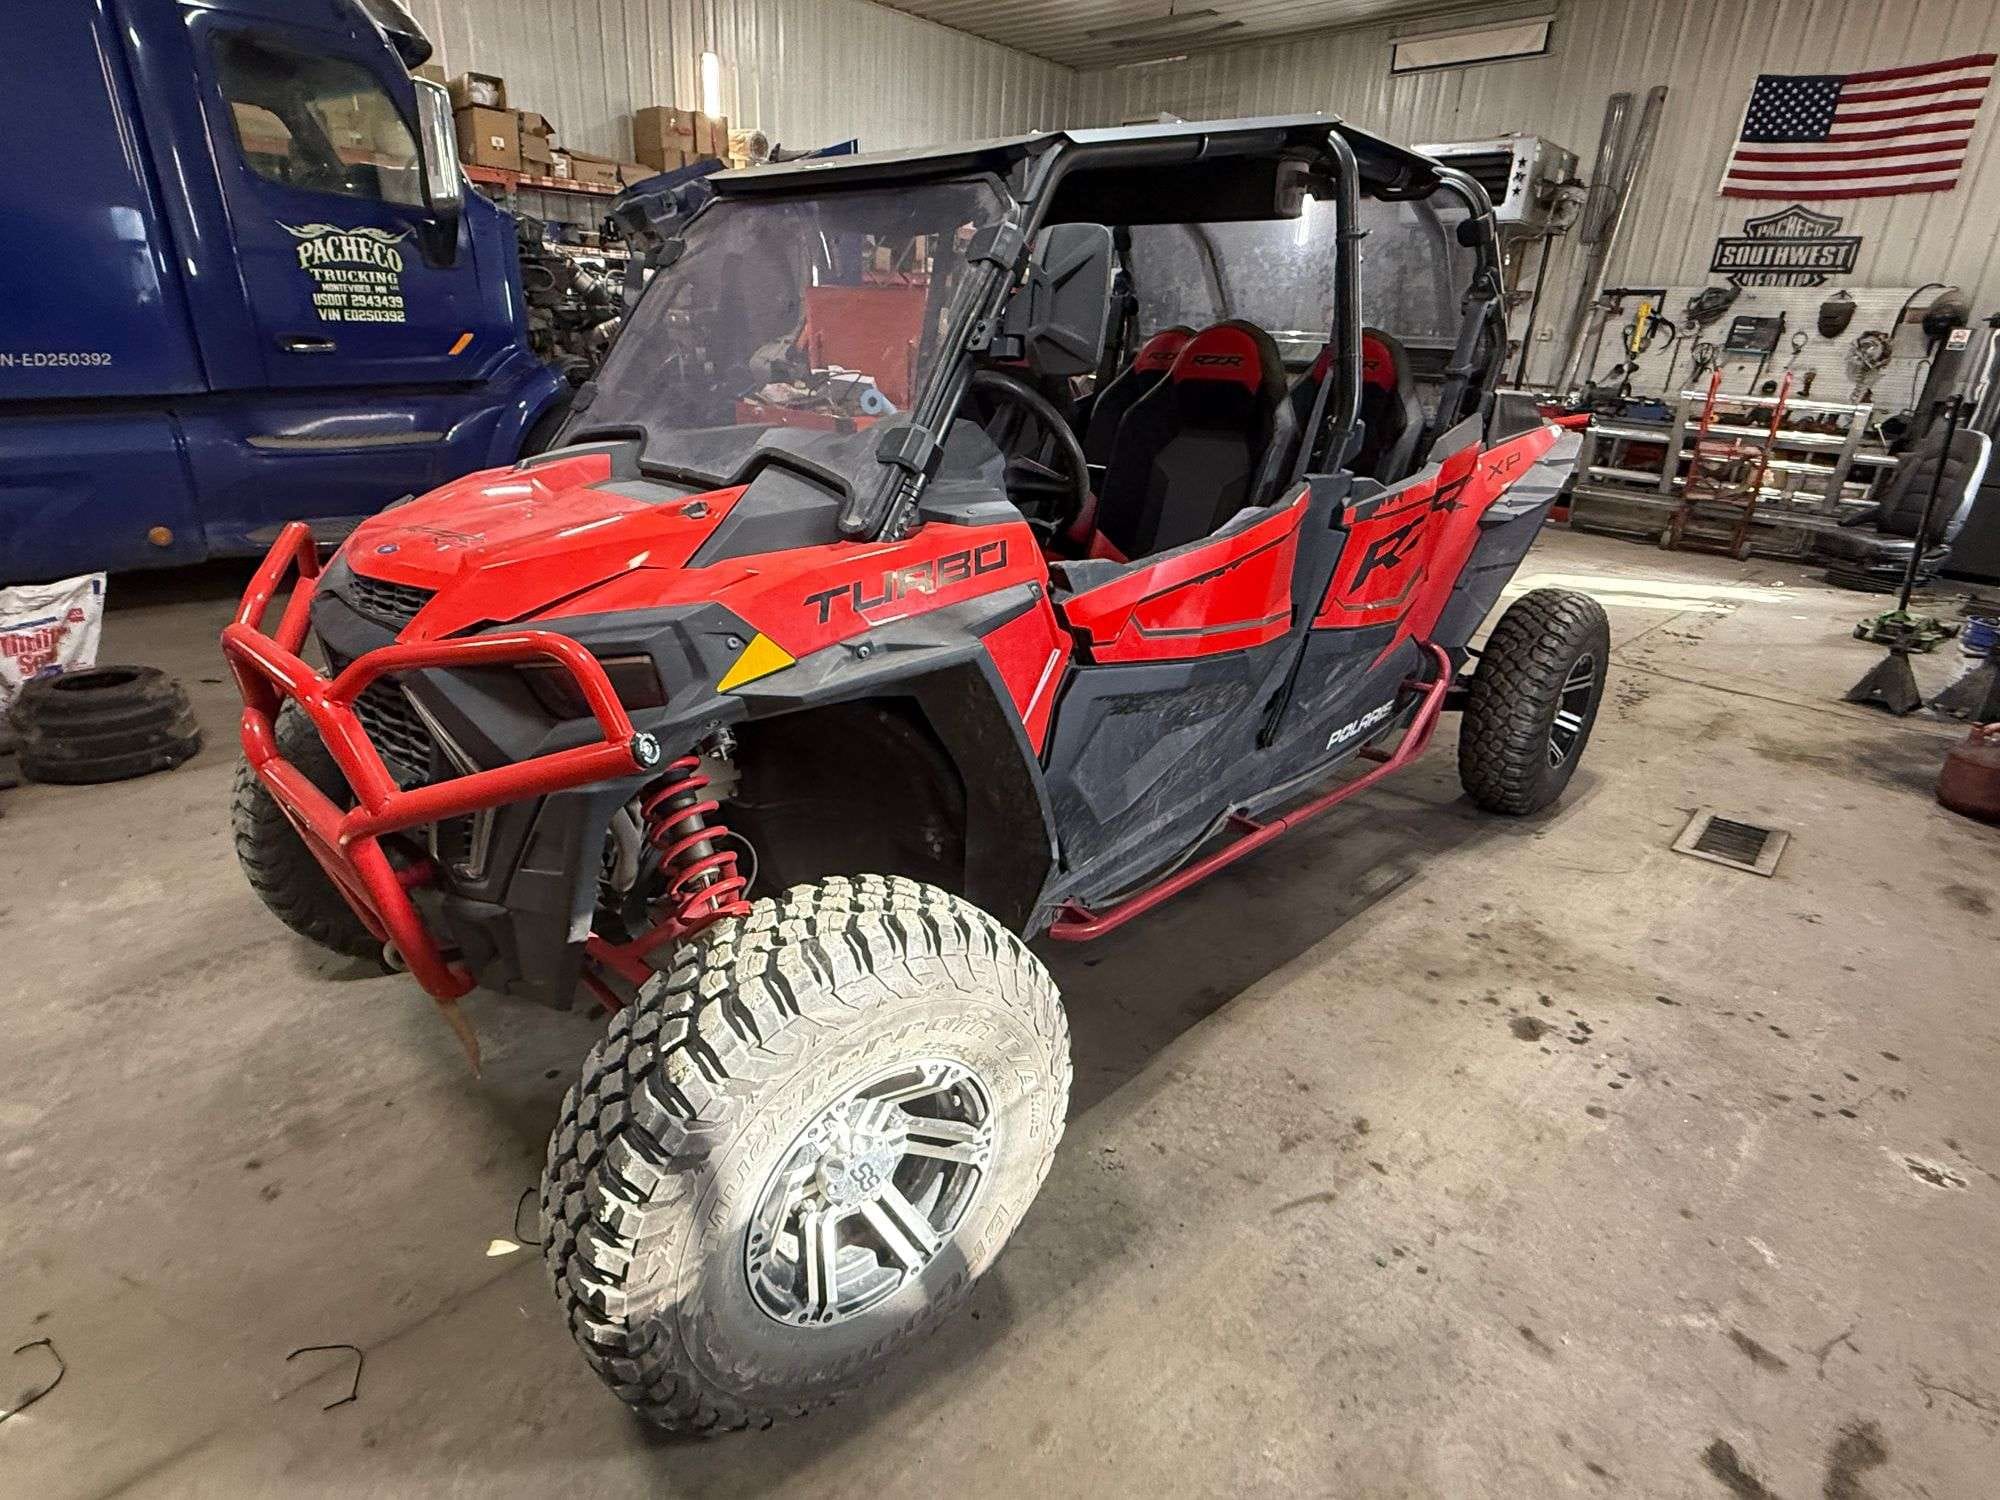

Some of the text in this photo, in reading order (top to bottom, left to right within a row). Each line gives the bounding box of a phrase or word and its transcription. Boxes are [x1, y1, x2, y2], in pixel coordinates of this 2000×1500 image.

[296, 234, 403, 273] PACHECO
[1720, 244, 1850, 267] SOUTHWEST
[310, 268, 399, 284] TRUCKING
[312, 293, 404, 309] USDOT 2943439
[318, 308, 341, 321] VIN
[1488, 452, 1521, 480] XP
[803, 539, 1008, 624] TURBO
[1325, 699, 1396, 751] POLARIS
